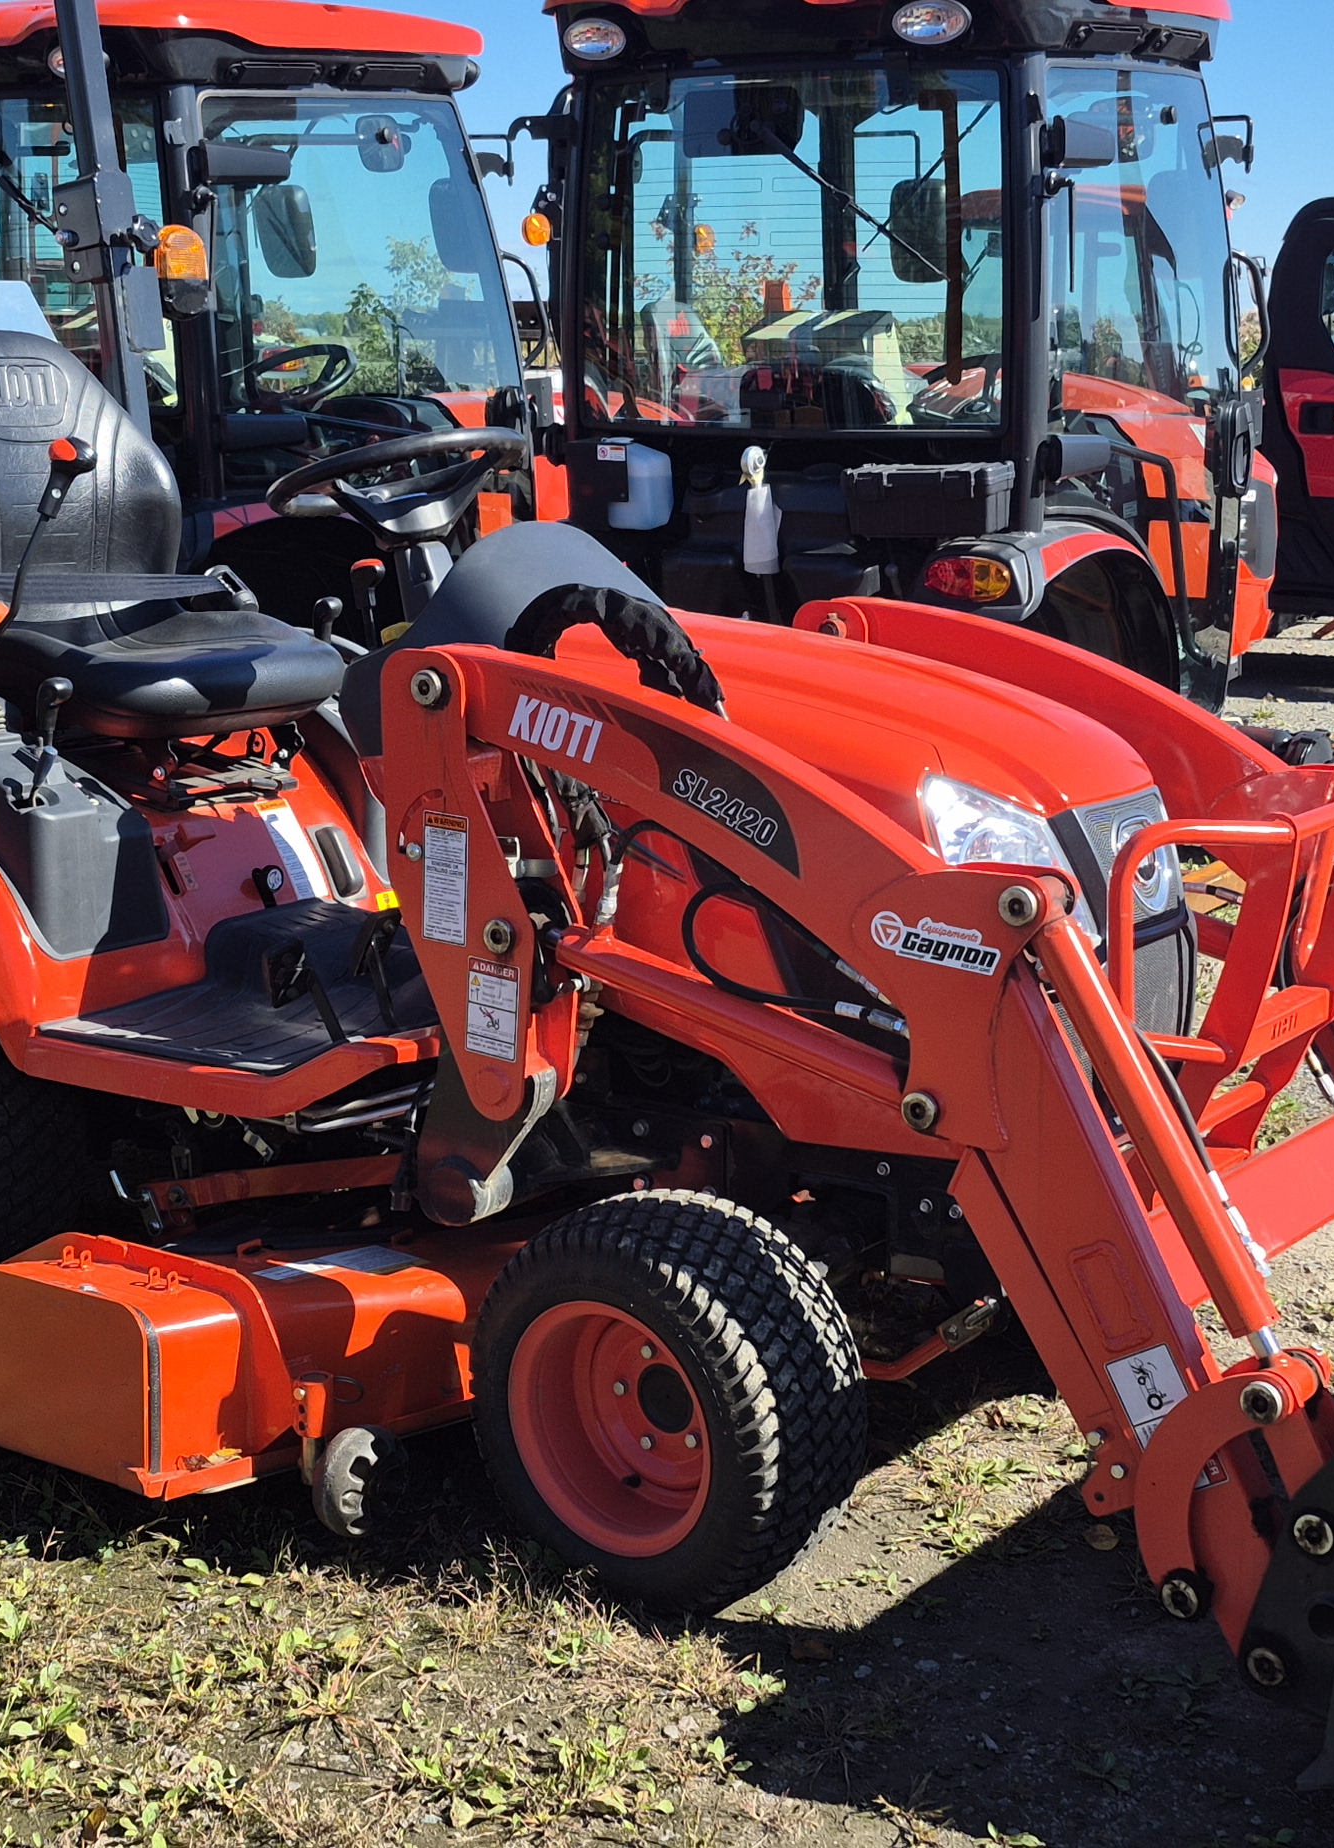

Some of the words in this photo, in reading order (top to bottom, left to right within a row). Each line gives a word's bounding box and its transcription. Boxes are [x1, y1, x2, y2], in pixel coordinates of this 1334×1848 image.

[507, 694, 604, 765] KIOTI
[672, 768, 778, 847] SL2420
[479, 963, 515, 979] DANGER
[901, 931, 997, 967] Gagnon
